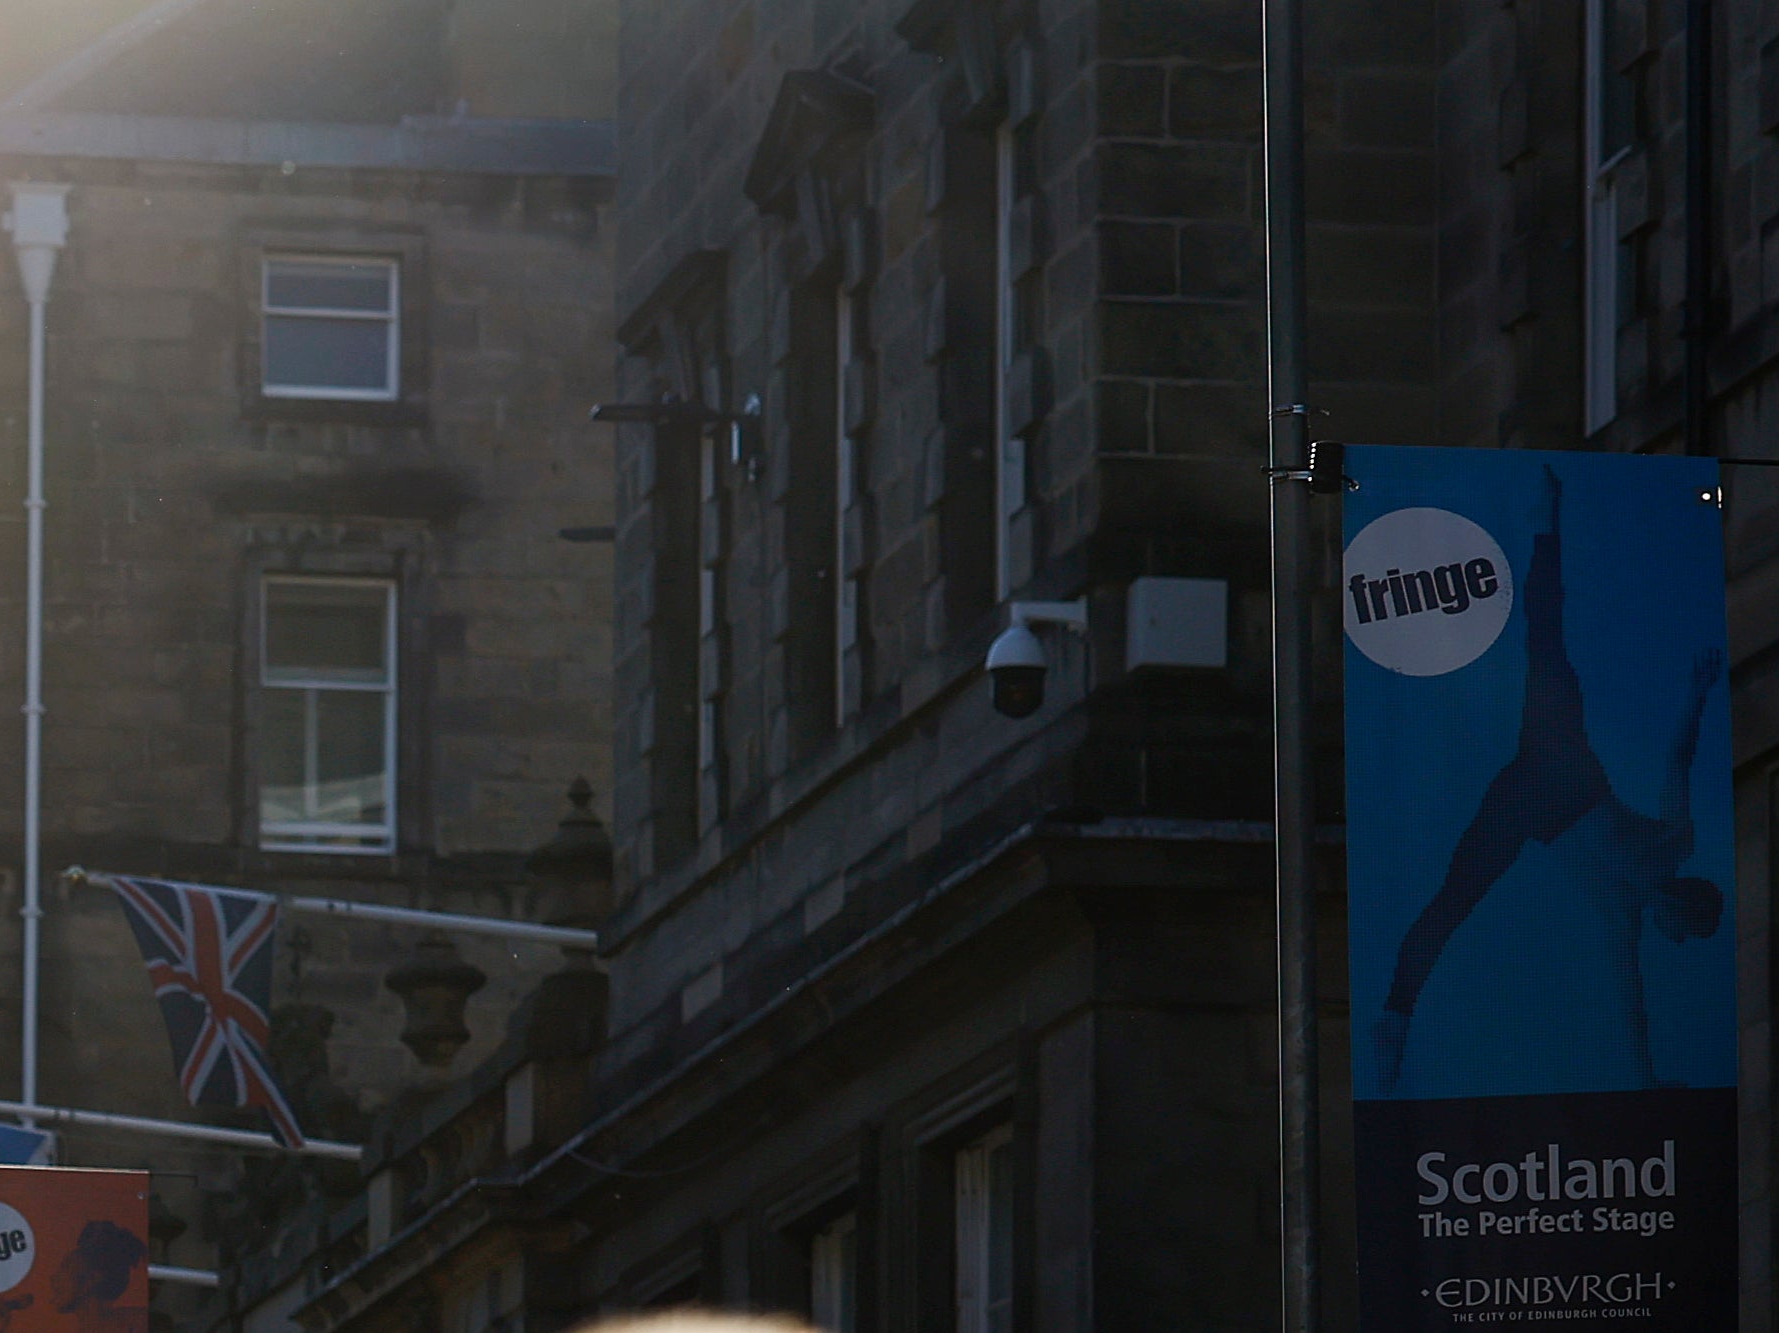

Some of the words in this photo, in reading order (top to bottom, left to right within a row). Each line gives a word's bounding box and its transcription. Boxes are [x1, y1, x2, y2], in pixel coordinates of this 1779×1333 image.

[1349, 558, 1498, 624] fringe
[1416, 1139, 1676, 1206] Scotland
[1417, 1211, 1470, 1238] The
[1478, 1207, 1585, 1236] Perfect
[1592, 1206, 1676, 1237] Stage
[1452, 1312, 1474, 1323] THE
[1478, 1311, 1505, 1323] CITY
[1508, 1310, 1524, 1321] OF
[1527, 1308, 1598, 1321] EDINBURGH
[1601, 1307, 1652, 1319] COUNCIL
